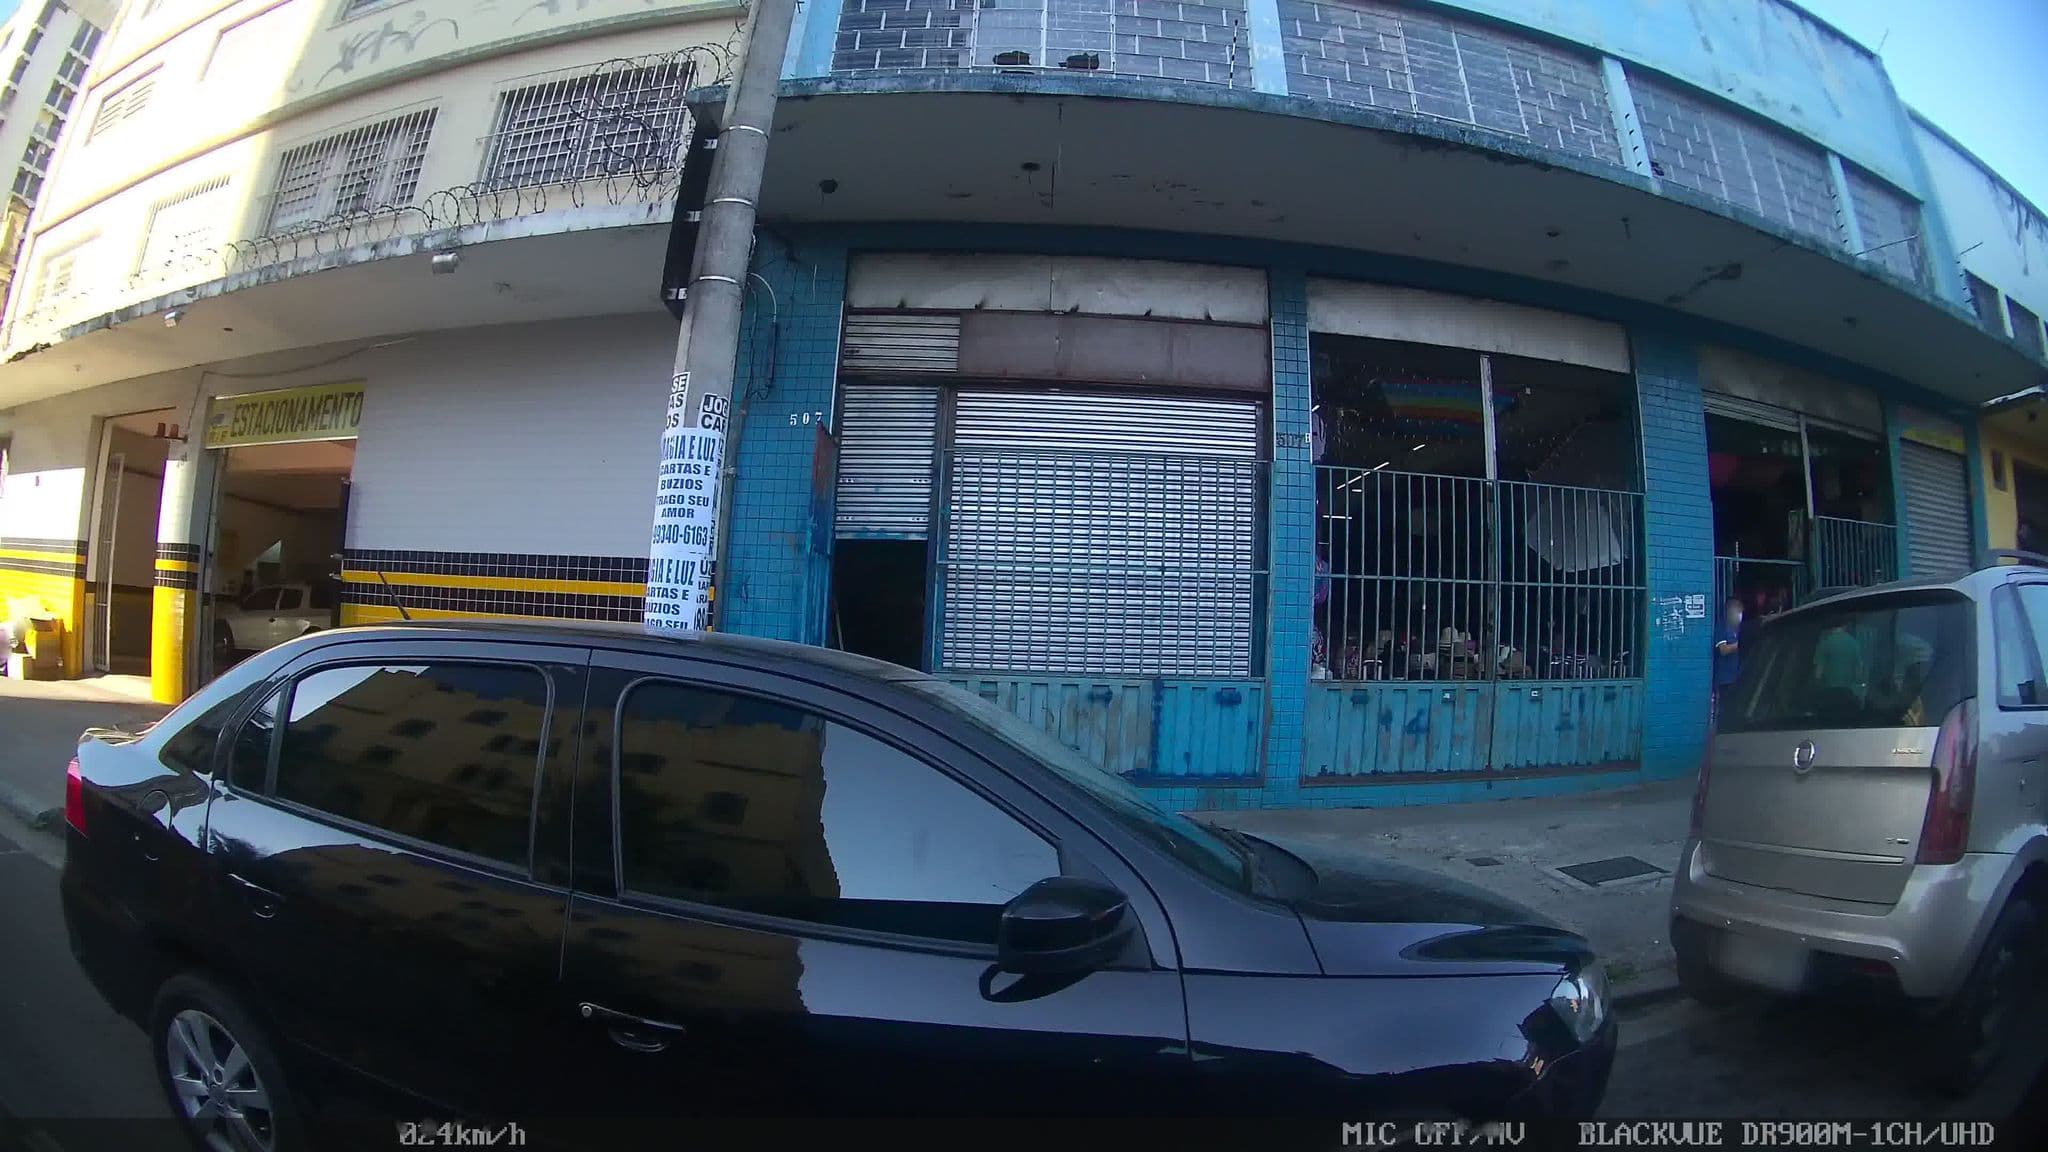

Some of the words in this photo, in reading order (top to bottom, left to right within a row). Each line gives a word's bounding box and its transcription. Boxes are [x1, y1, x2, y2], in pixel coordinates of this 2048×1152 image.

[230, 391, 364, 438] ESTACIONAMENTO
[688, 435, 697, 460] E
[697, 436, 716, 462] LUZ
[704, 465, 712, 476] E
[660, 478, 703, 491] BUZIOS
[688, 495, 709, 507] SEU
[661, 507, 695, 519] AMOR
[666, 558, 673, 583] E
[674, 560, 696, 586] LUZ
[681, 589, 690, 601] E
